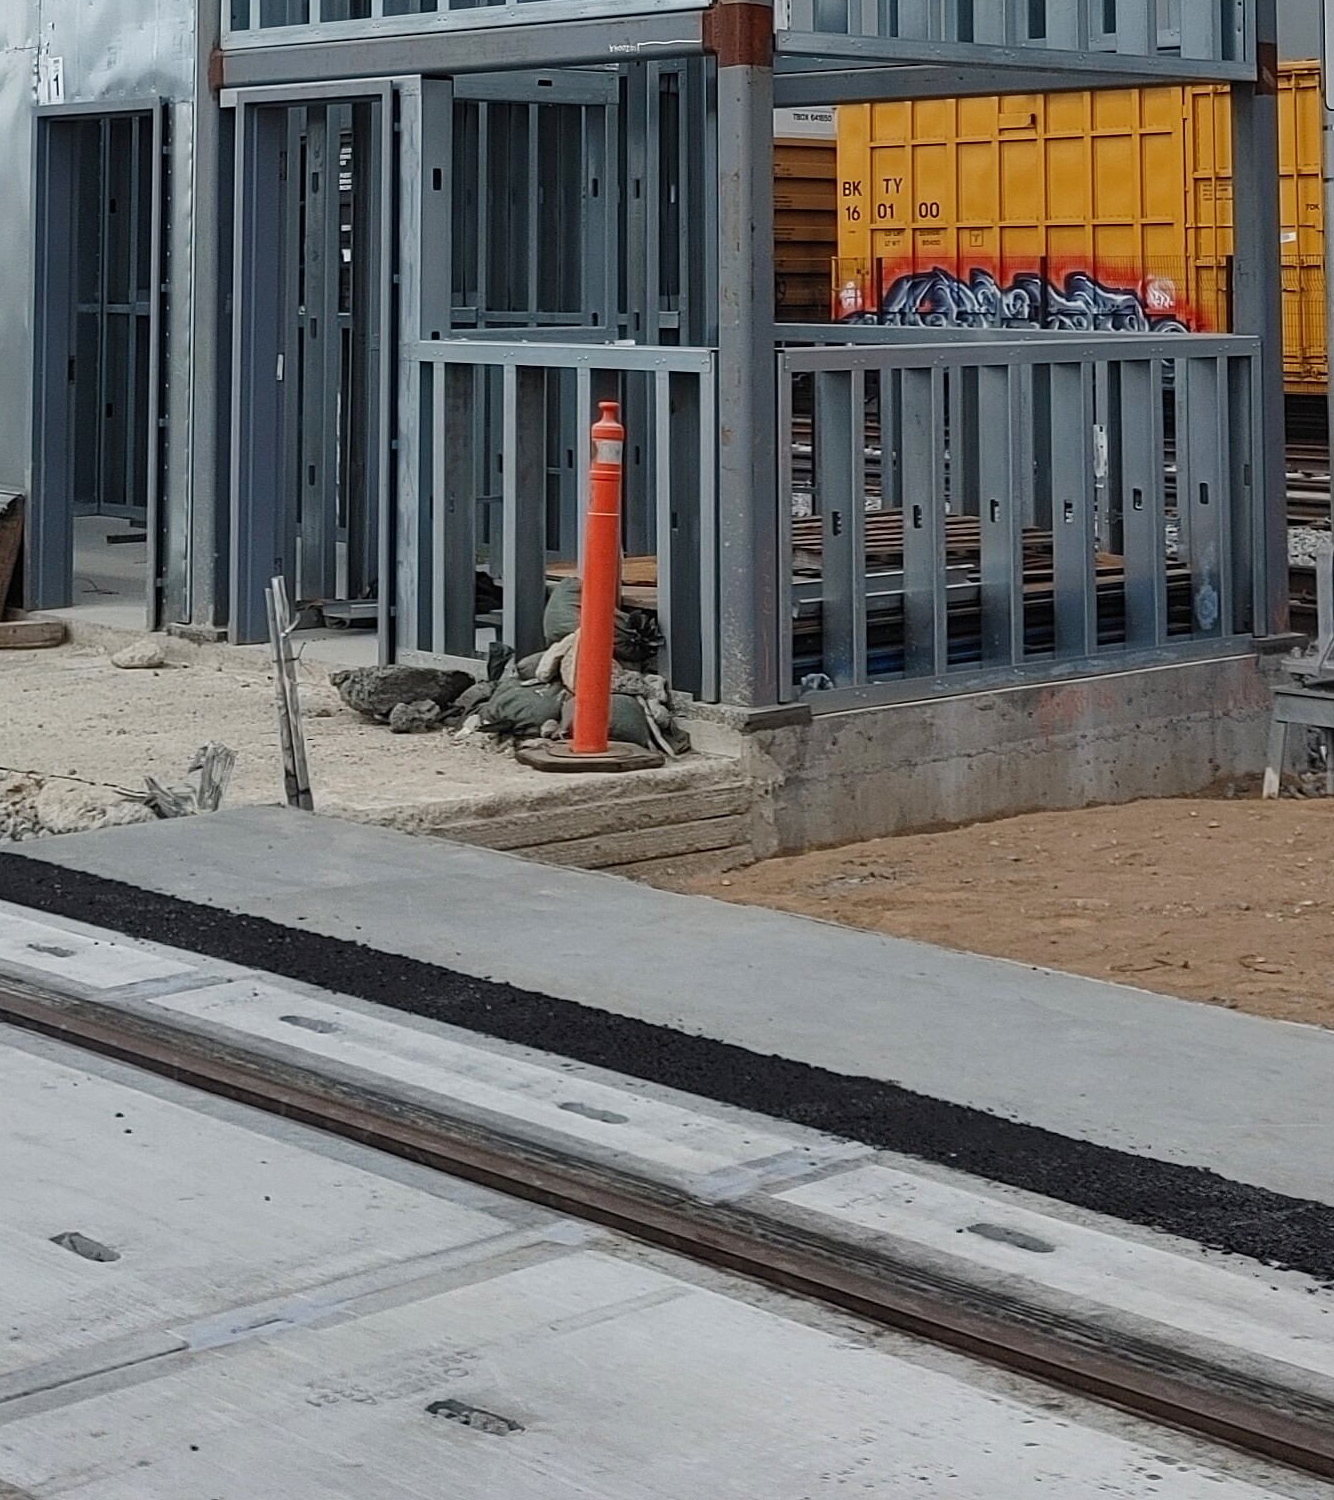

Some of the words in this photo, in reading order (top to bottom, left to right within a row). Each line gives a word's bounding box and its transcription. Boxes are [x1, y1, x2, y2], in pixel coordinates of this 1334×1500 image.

[842, 180, 862, 197] BK
[882, 177, 903, 194] TY
[845, 205, 861, 221] 16
[877, 203, 894, 219] 01
[918, 202, 940, 219] 00
